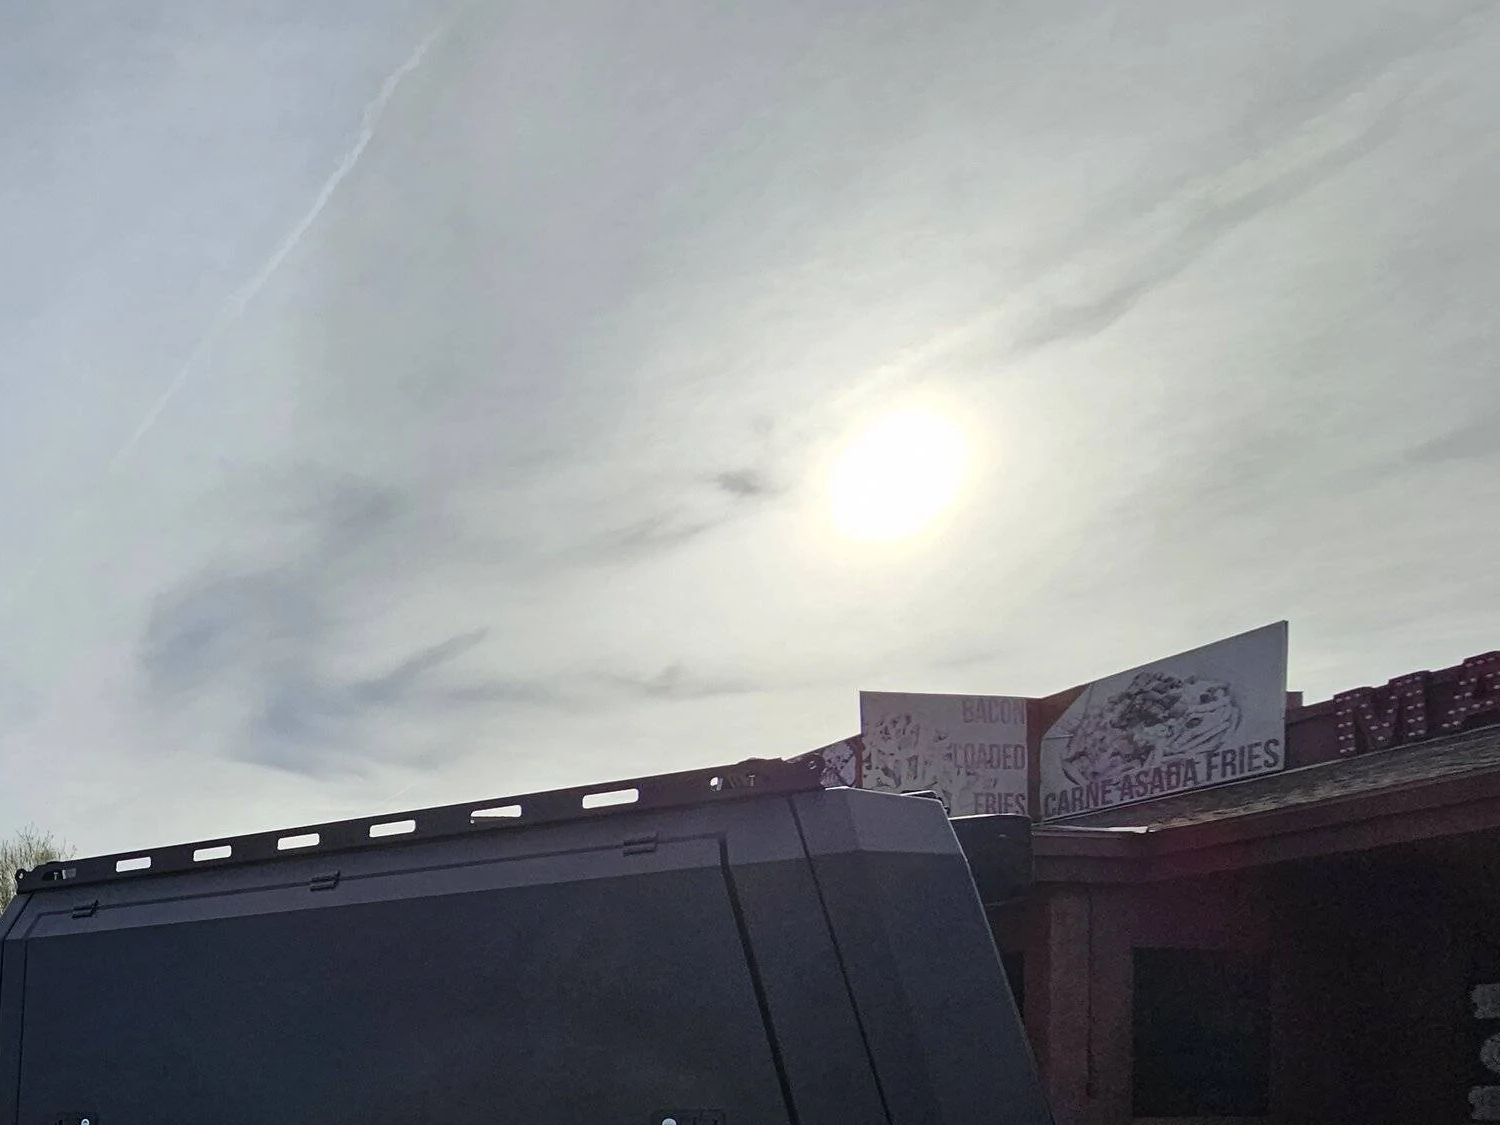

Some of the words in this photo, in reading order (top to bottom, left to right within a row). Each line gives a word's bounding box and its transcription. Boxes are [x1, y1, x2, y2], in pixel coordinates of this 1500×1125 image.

[952, 742, 1026, 770] LOADED
[1044, 778, 1112, 816] CARNE
[1118, 758, 1201, 801] ASADA
[1205, 738, 1281, 782] FRIES
[973, 792, 1026, 816] FRIES
